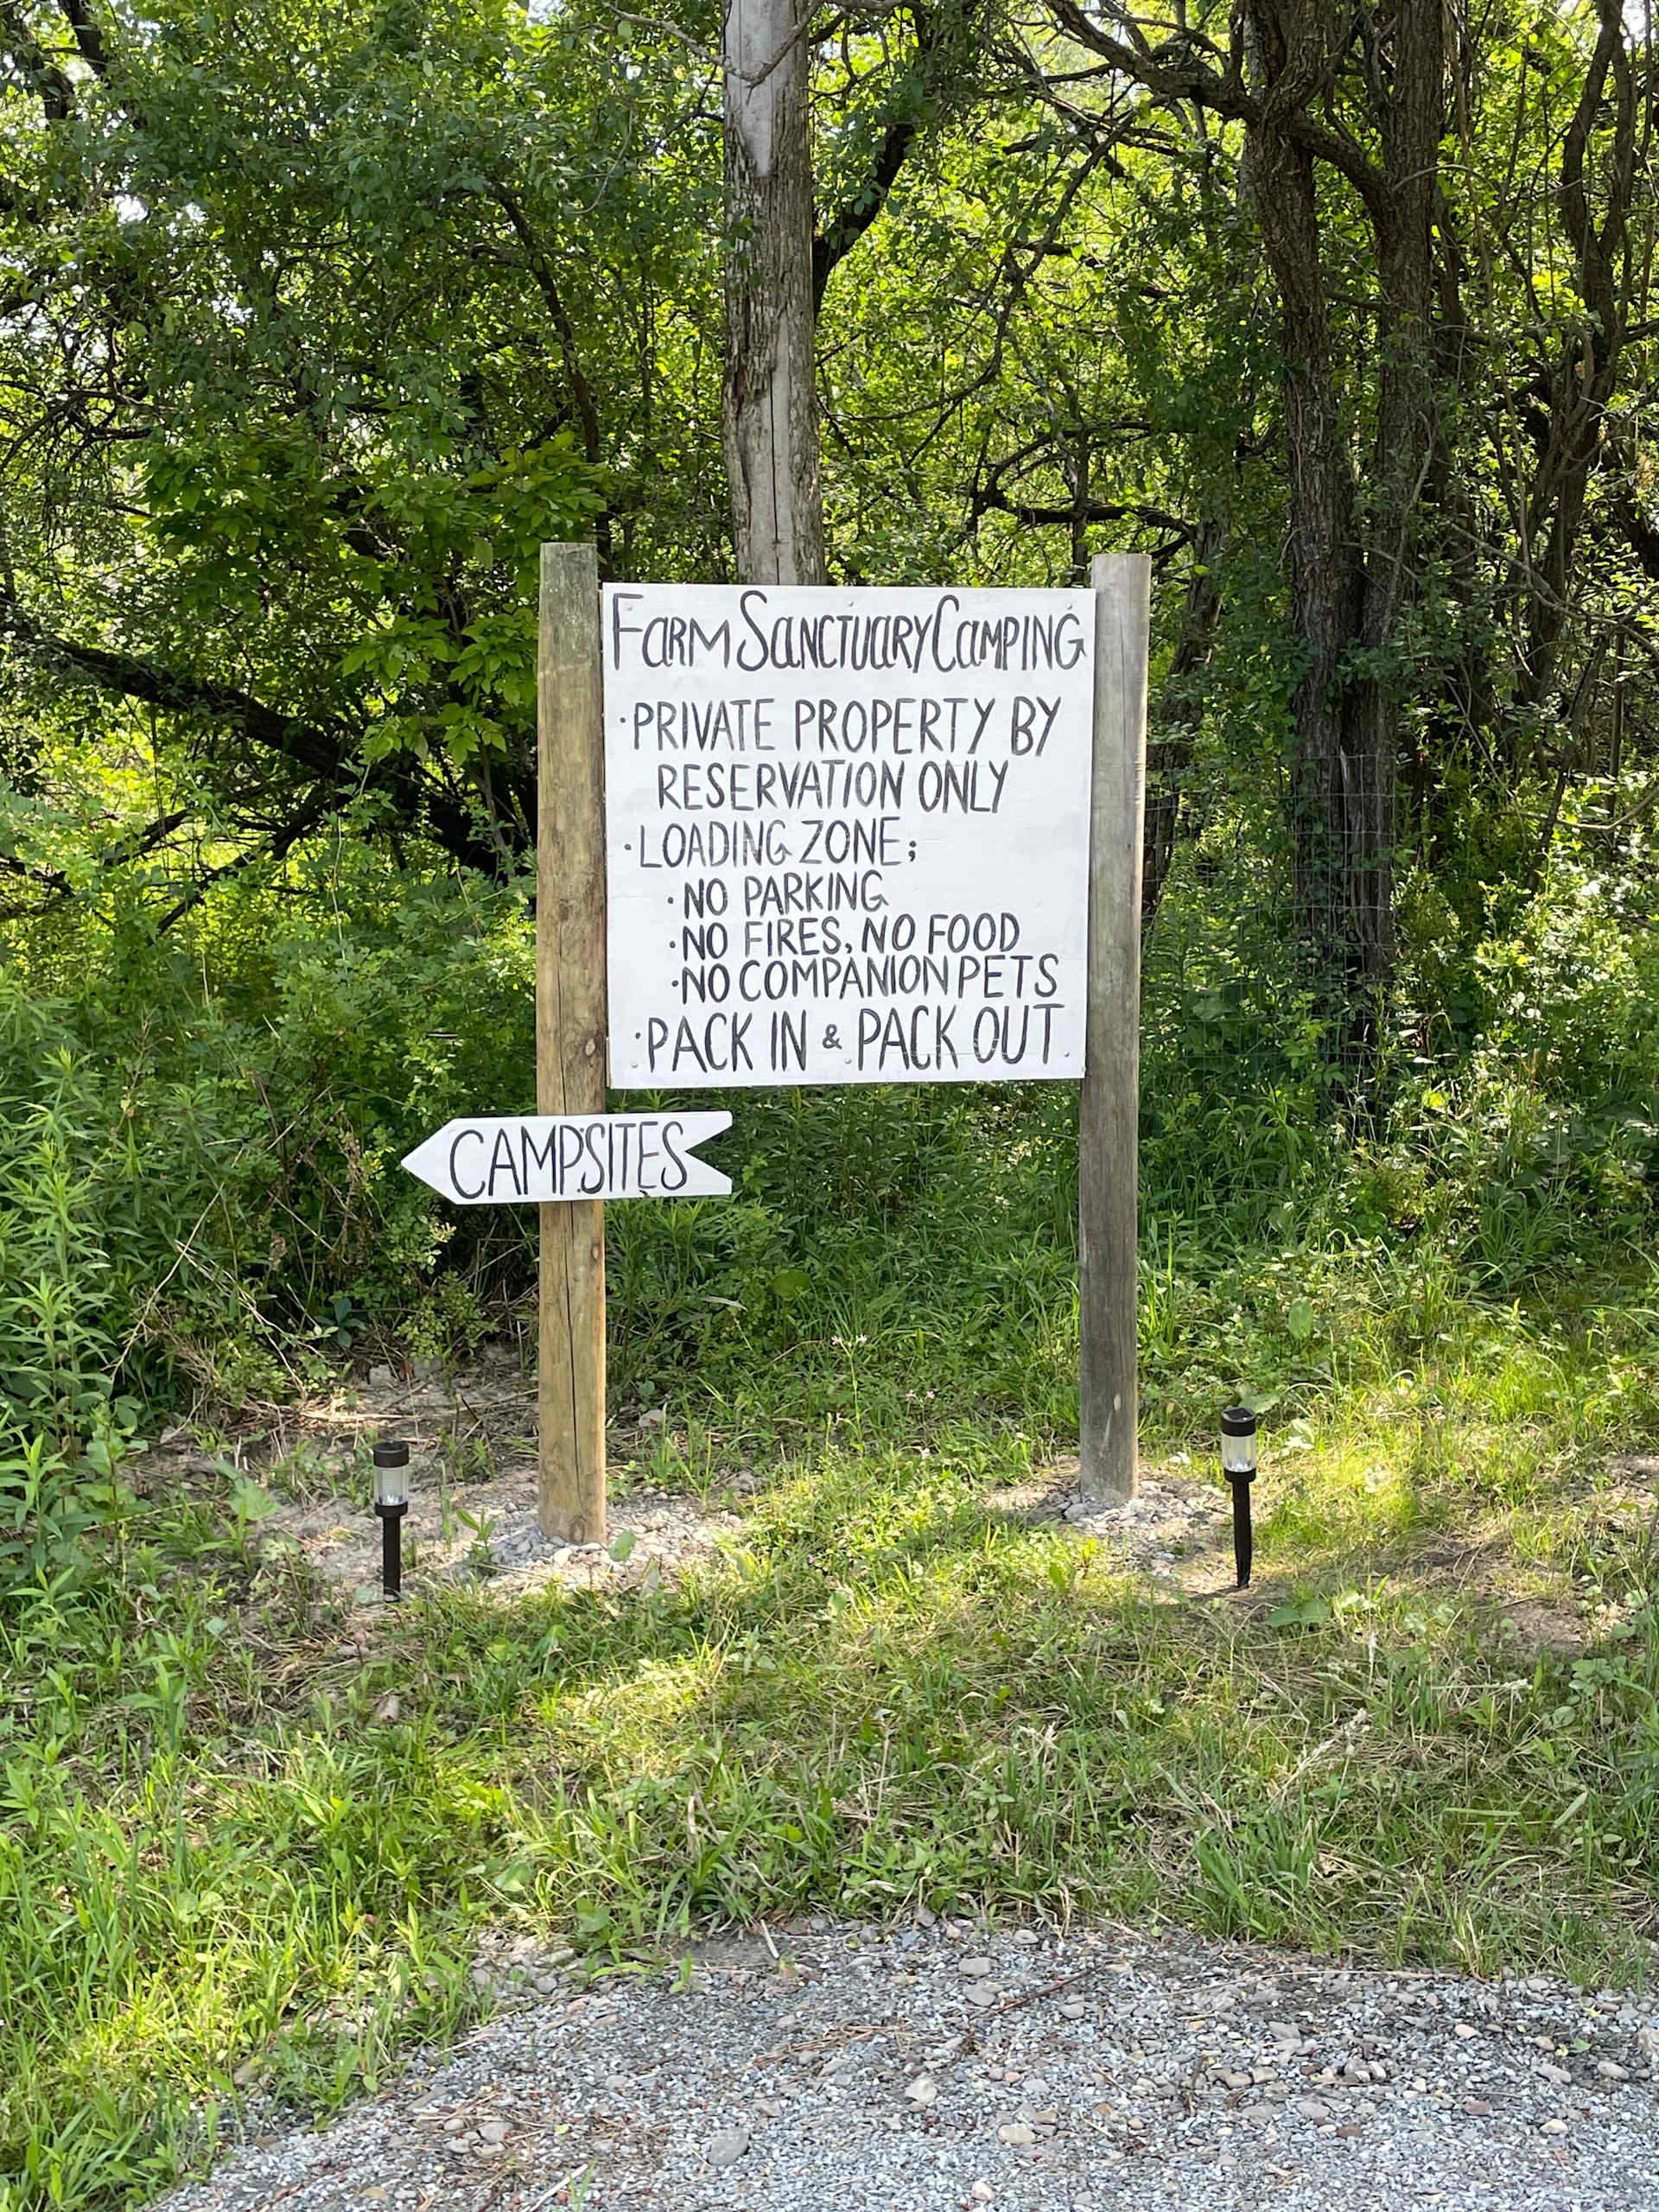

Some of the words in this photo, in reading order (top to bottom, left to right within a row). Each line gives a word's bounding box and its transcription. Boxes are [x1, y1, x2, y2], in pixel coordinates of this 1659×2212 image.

[634, 699, 774, 751] PRIVATE
[796, 698, 995, 754] PROPERTY
[1011, 696, 1060, 756] BY
[658, 760, 904, 810] RESERVATION
[918, 760, 1008, 813] ONLY
[640, 822, 791, 868] LOADING
[684, 878, 728, 919] NO
[745, 870, 888, 917] PARKING
[683, 923, 728, 961] NO
[745, 916, 852, 957] FIRES,
[861, 914, 915, 953] NO
[928, 912, 1020, 953] FOOD
[682, 963, 730, 1004] NO
[740, 953, 948, 1001] COMPANION
[958, 954, 1058, 998] PETS
[649, 1013, 753, 1073] PACK
[771, 1010, 806, 1071] IN
[823, 1024, 842, 1049] &
[858, 1005, 958, 1071] PACK
[974, 1004, 1065, 1065] OUT
[449, 1122, 687, 1198] CAMPSITES
